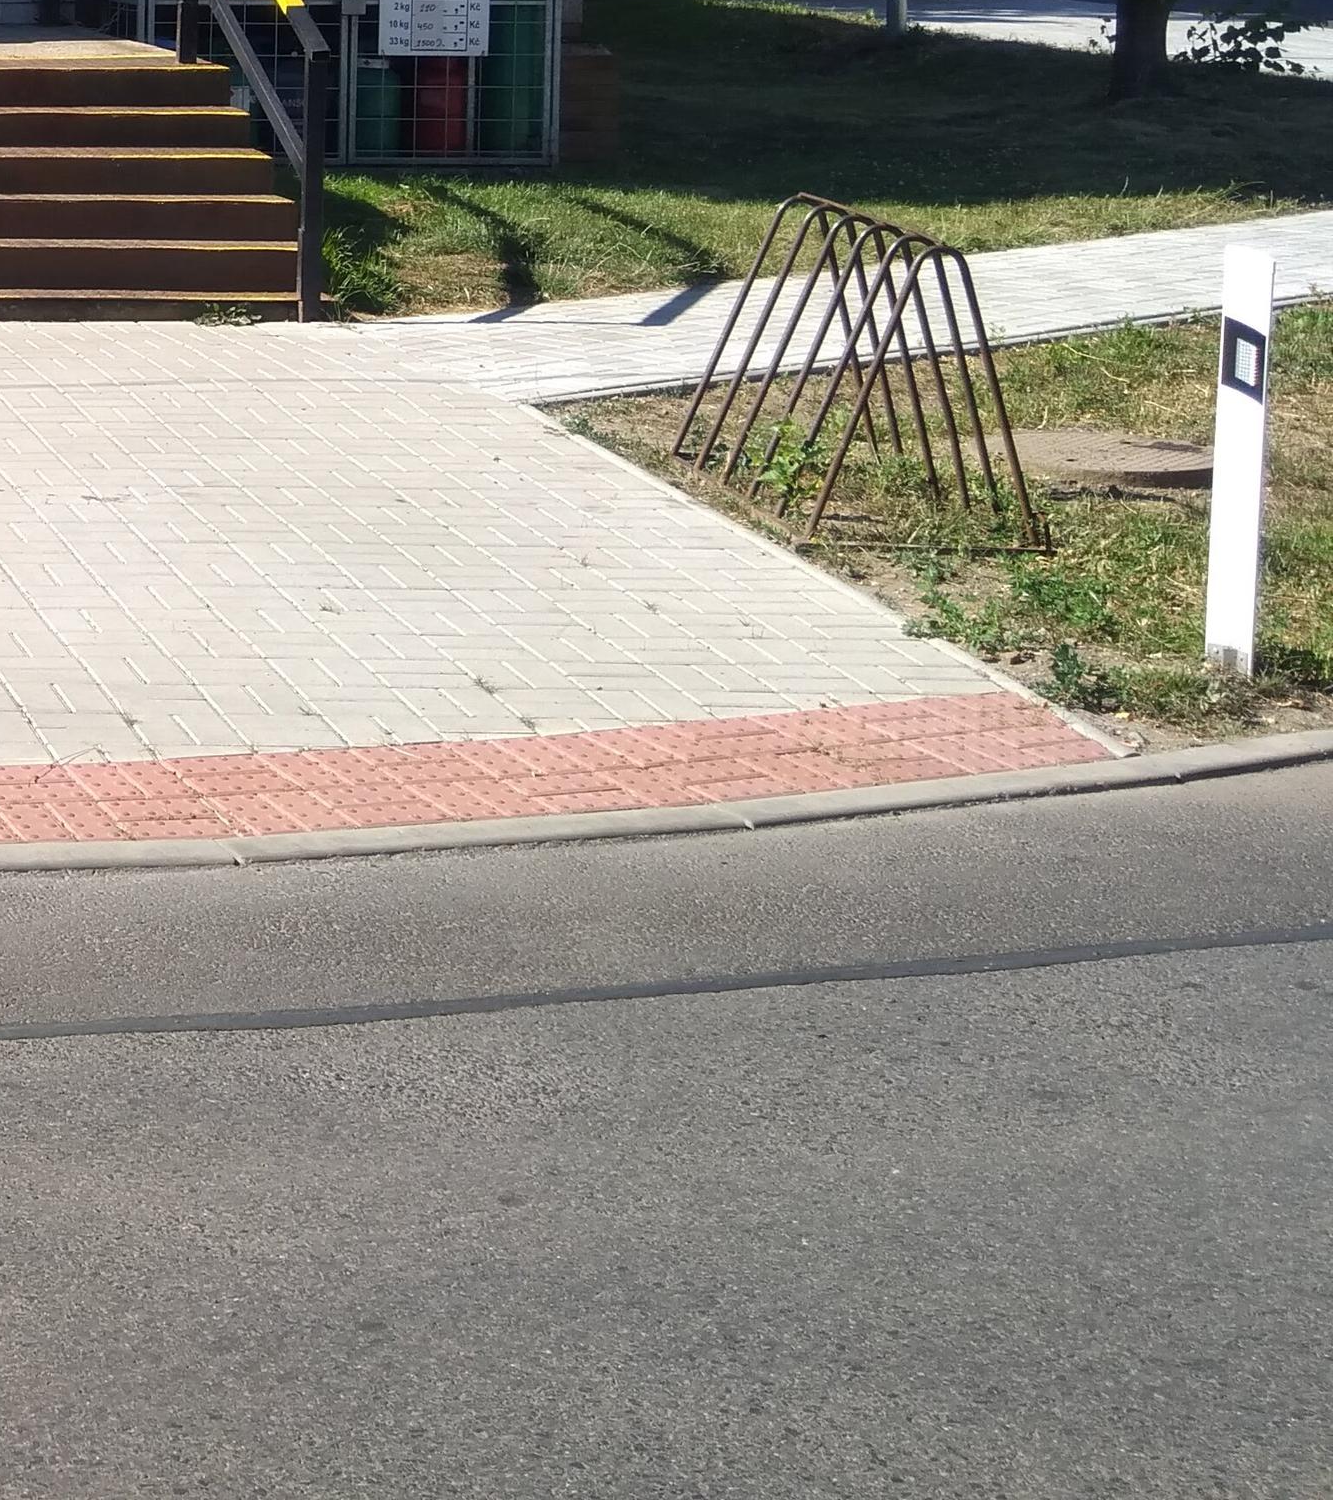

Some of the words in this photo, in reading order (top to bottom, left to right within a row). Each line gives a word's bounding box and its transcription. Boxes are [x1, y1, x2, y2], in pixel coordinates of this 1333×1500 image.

[469, 2, 481, 11] Kč
[469, 20, 481, 29] Kč
[389, 37, 398, 46] 33
[469, 36, 481, 46] Kč
